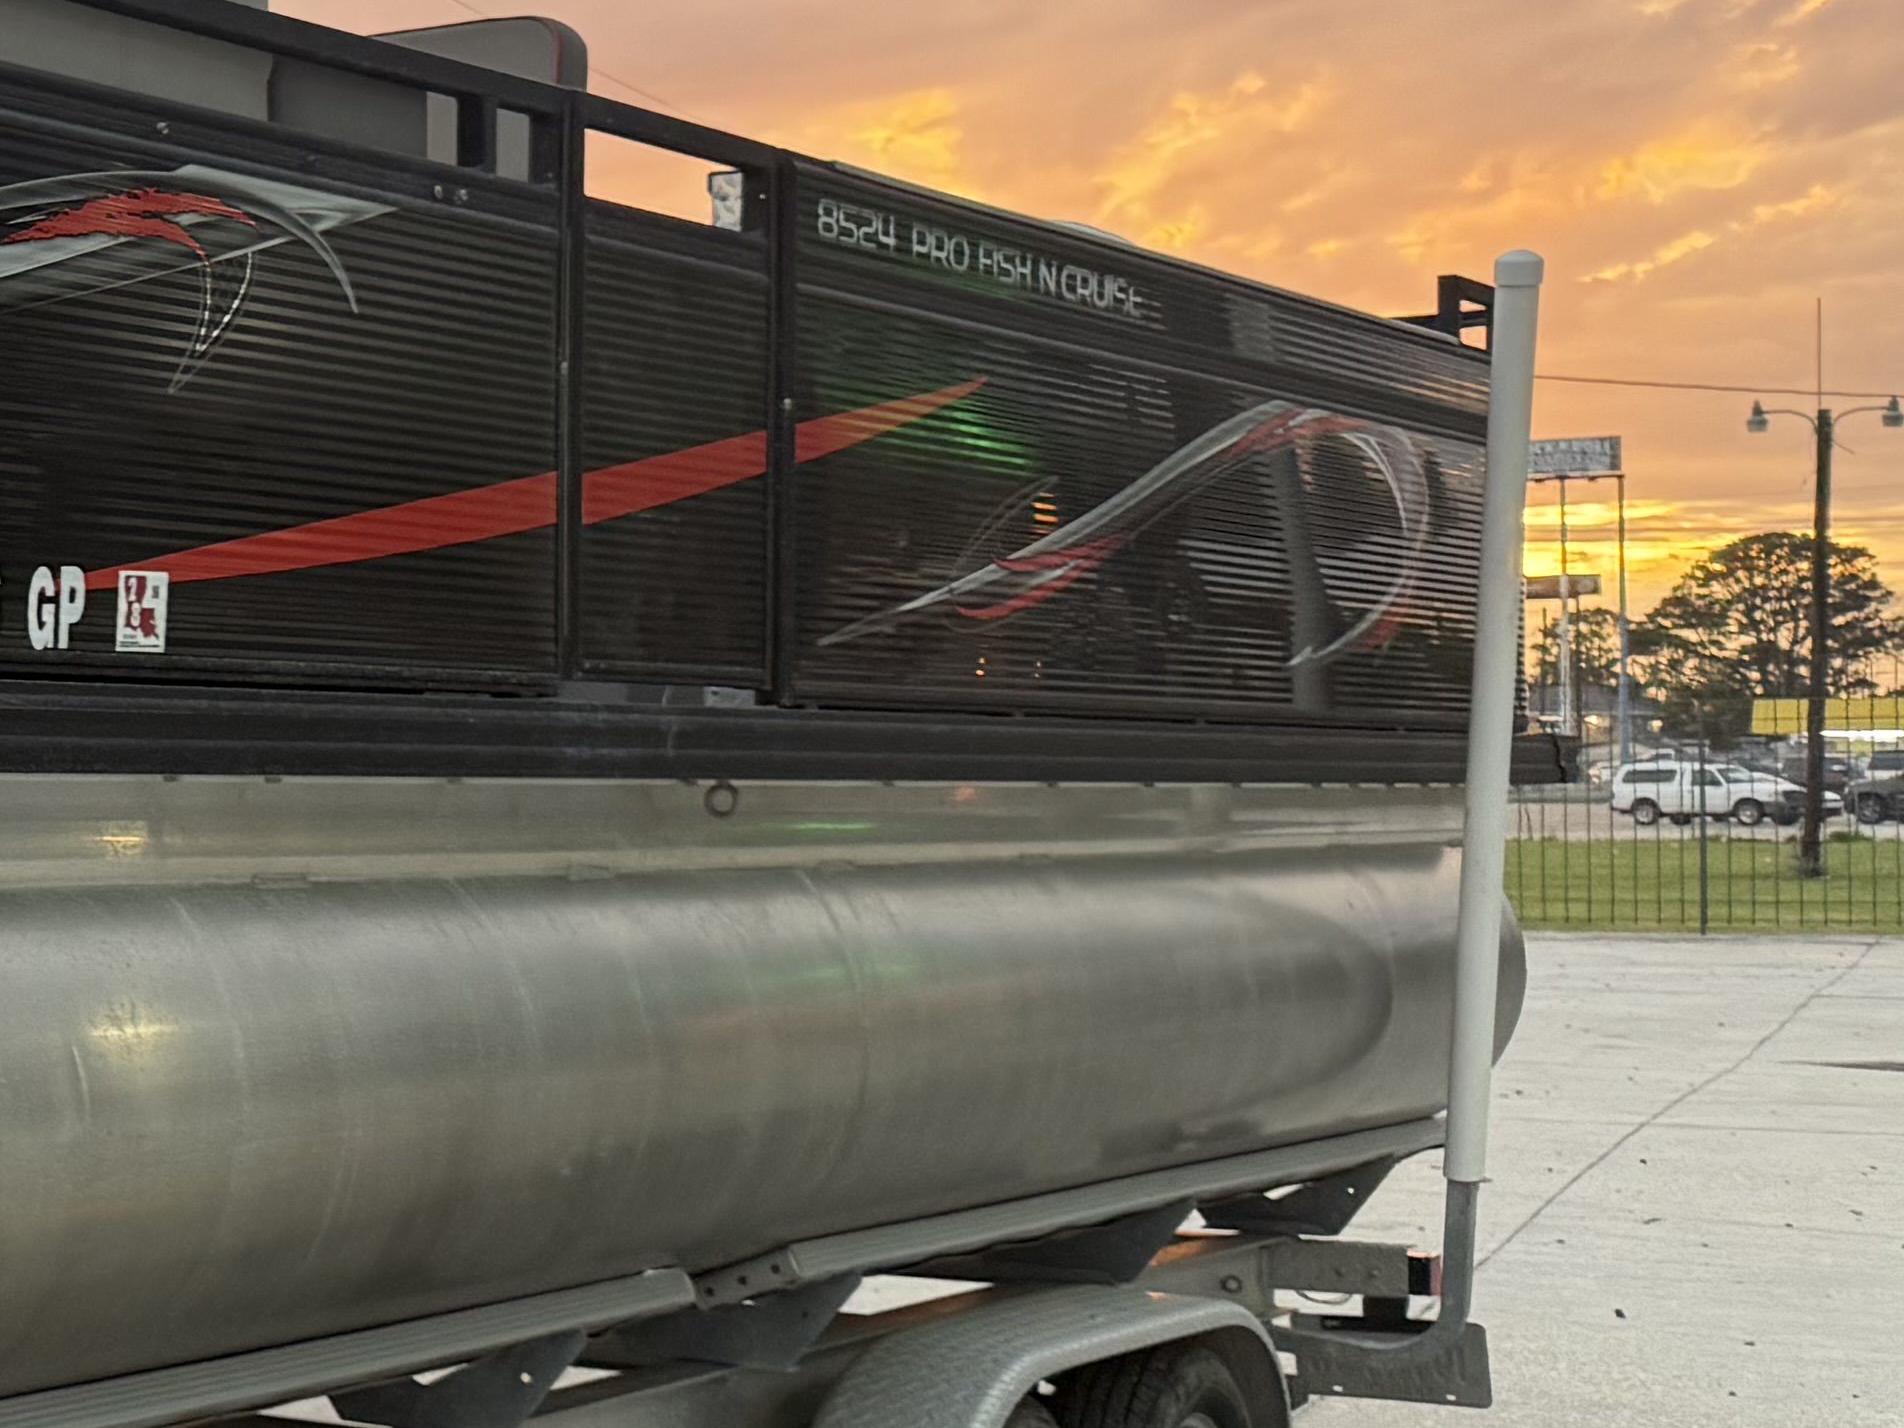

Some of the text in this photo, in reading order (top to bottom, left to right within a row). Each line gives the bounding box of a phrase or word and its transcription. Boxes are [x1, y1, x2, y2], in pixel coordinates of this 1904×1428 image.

[817, 198, 1142, 319] 8524 PRO FISH N CRUISE
[27, 565, 86, 651] GP
